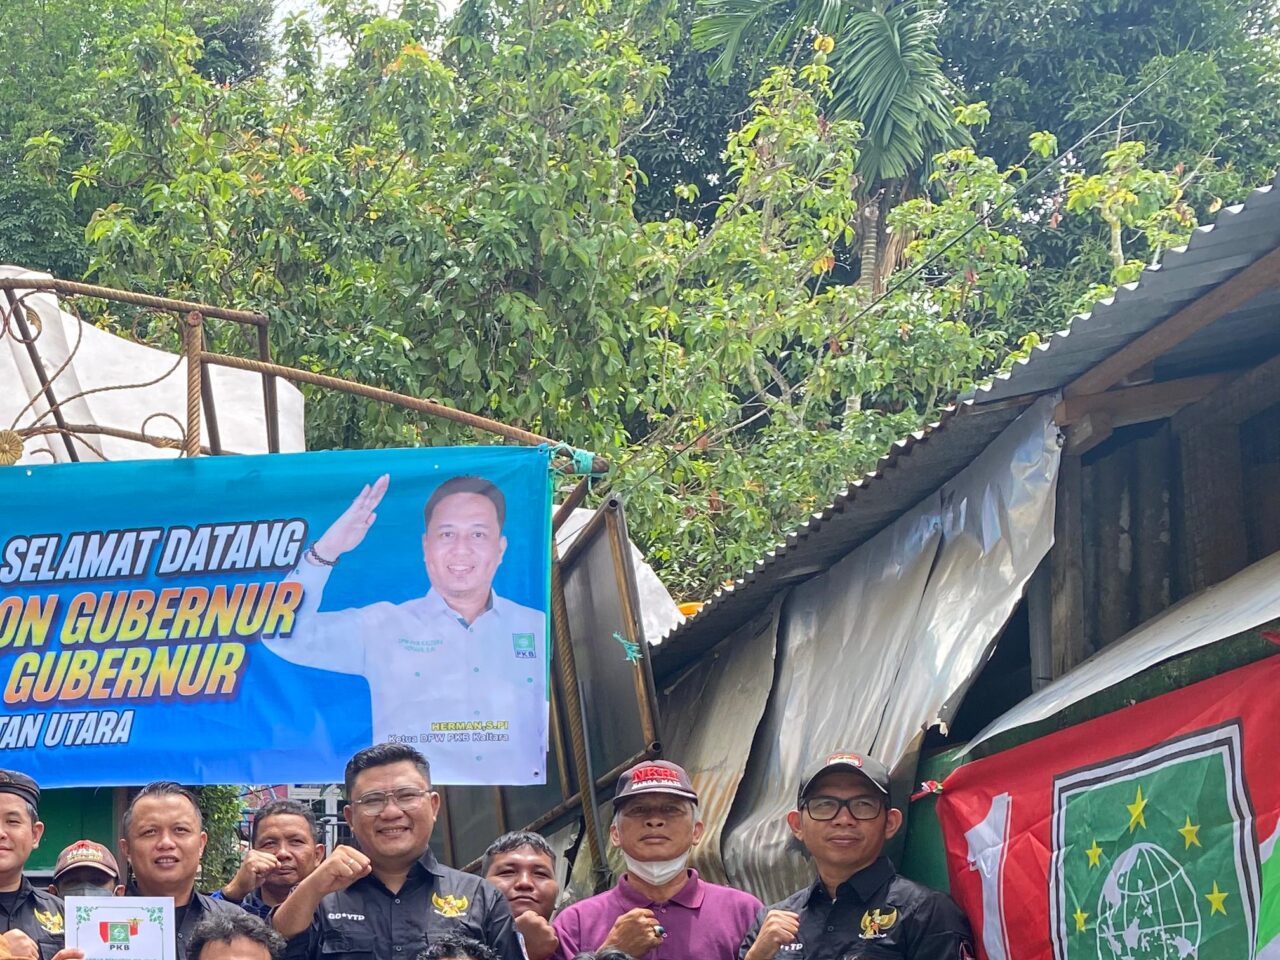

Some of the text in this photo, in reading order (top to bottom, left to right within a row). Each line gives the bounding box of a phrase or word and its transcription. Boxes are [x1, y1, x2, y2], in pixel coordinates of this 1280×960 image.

[157, 519, 306, 575] DATANG
[59, 581, 304, 645] GUBERNUR
[3, 642, 246, 704] GUBERNUR
[43, 709, 135, 748] UTARA
[388, 733, 509, 743] Ketua DPW PKB Kaltara
